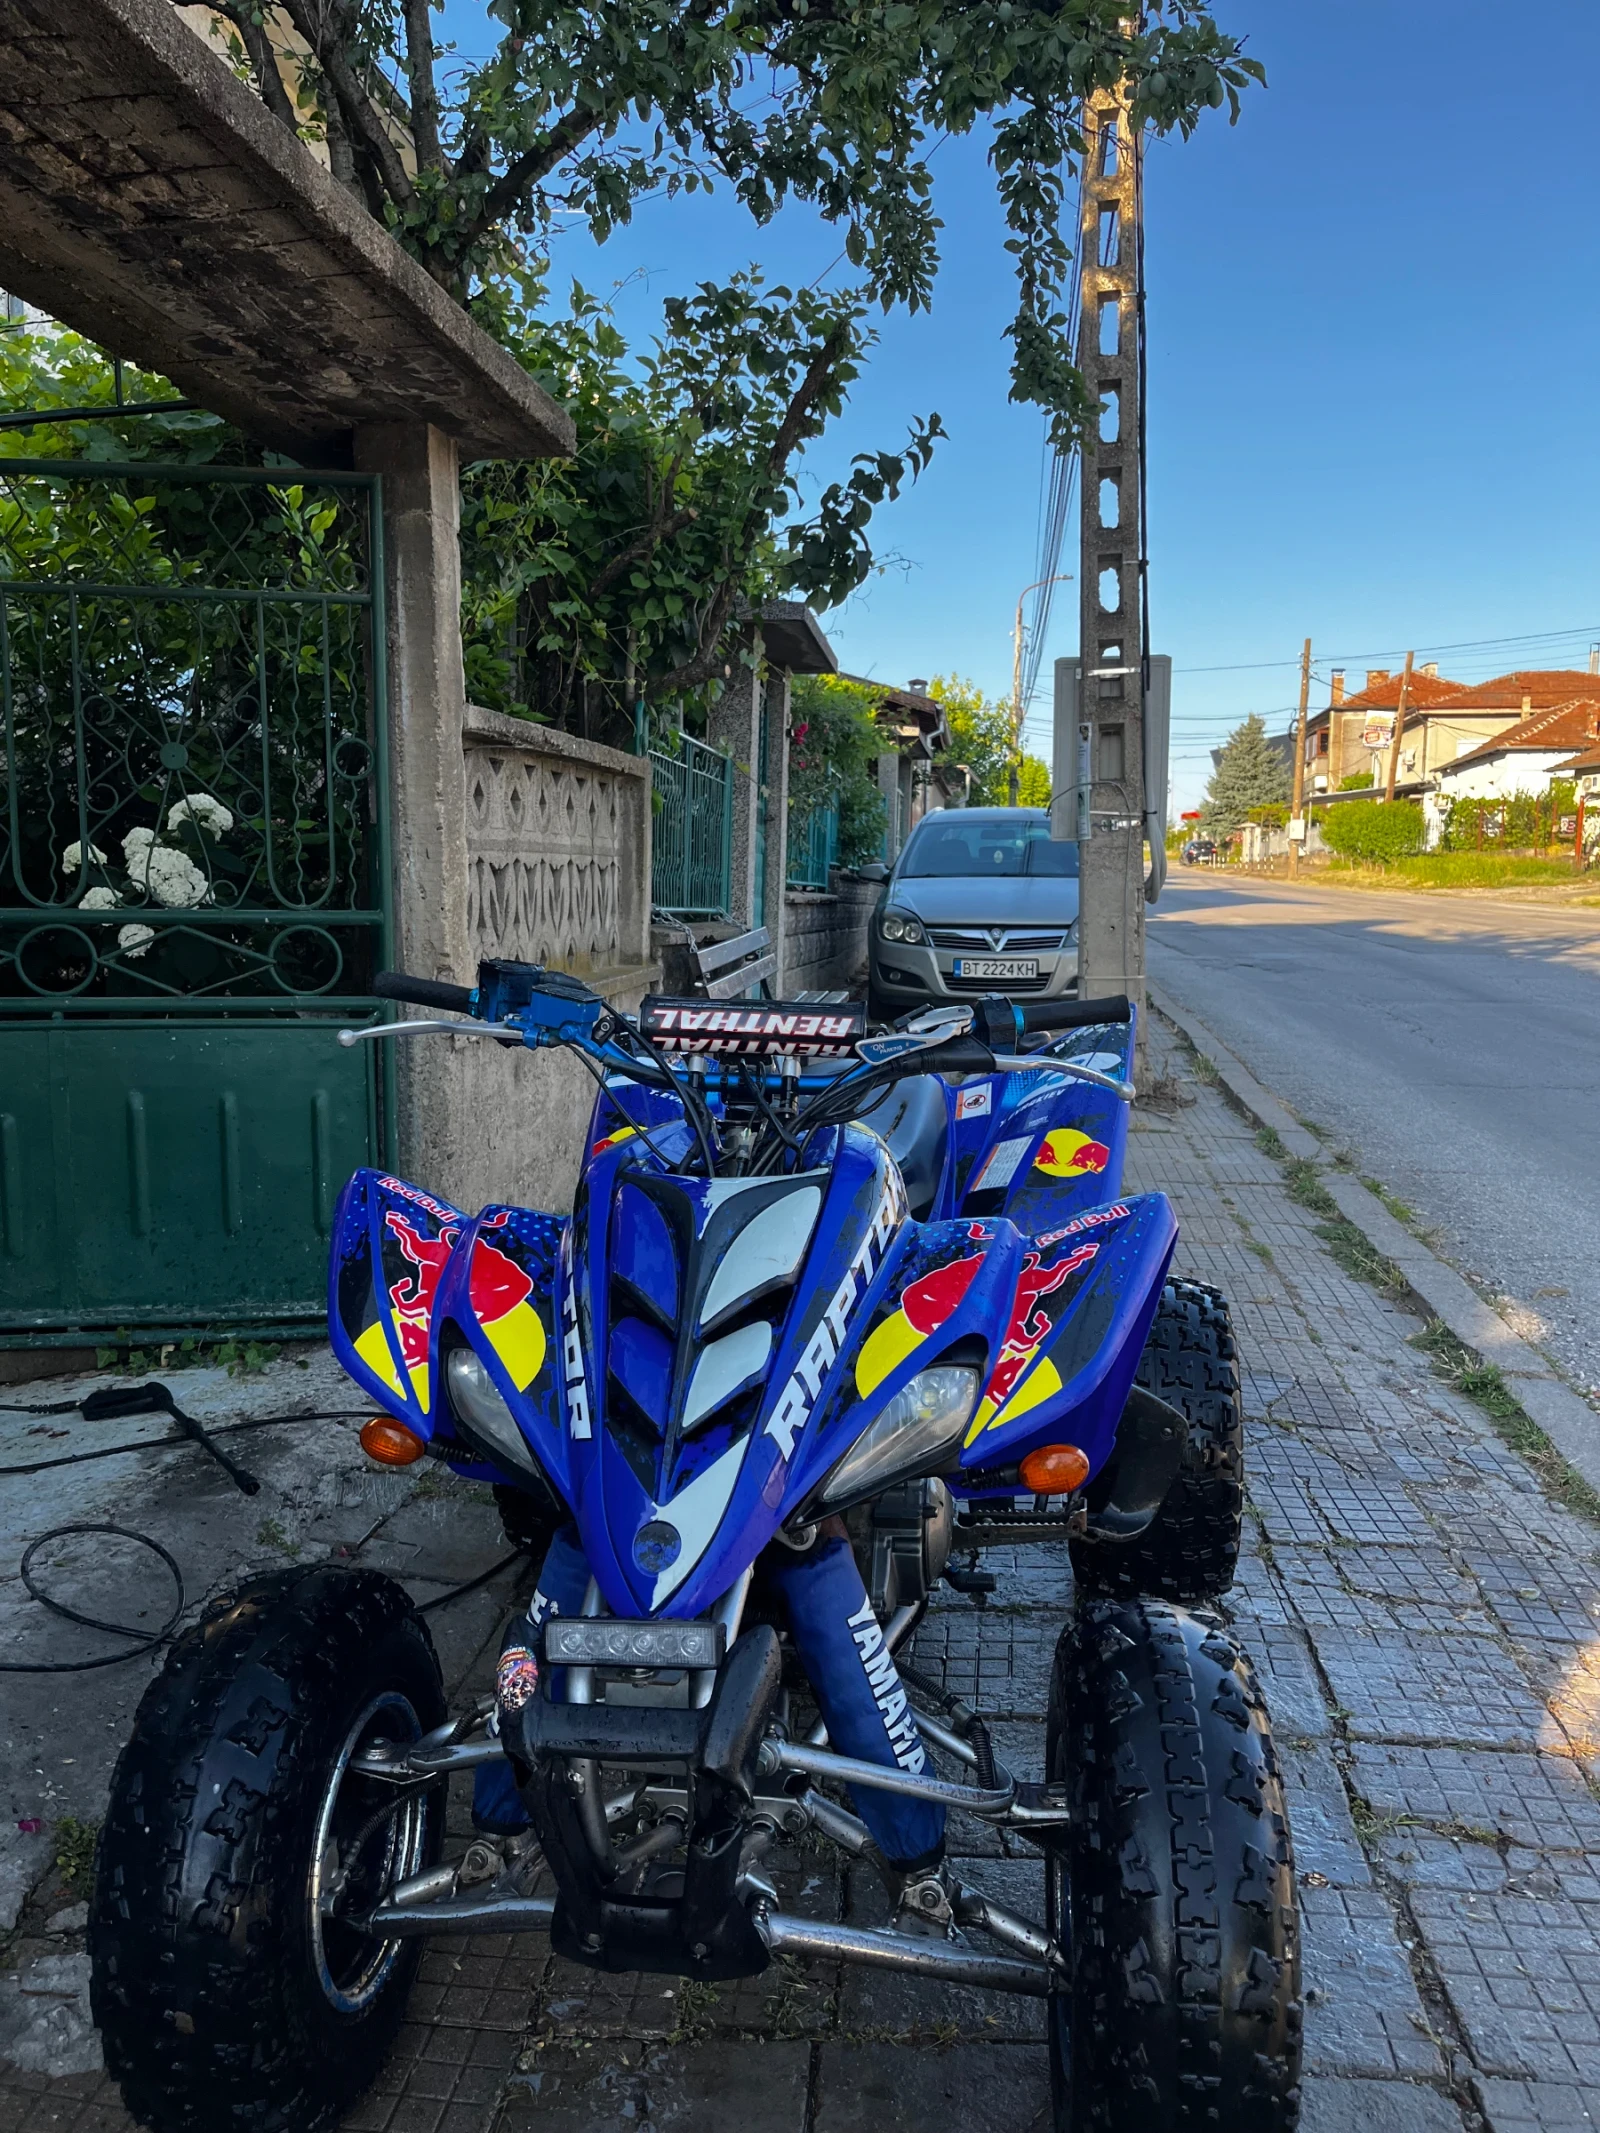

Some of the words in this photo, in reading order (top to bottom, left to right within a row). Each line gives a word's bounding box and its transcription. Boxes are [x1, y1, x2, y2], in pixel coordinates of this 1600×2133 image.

[963, 962, 980, 975] BT
[982, 963, 1014, 976] 2224
[1016, 963, 1035, 976] KH
[653, 1009, 854, 1037] RENTHAL
[377, 1177, 425, 1200] Red
[414, 1196, 460, 1223] Bull
[1035, 1220, 1082, 1248] Red
[1080, 1204, 1131, 1228] Bull
[847, 1593, 926, 1776] YAMAHA
